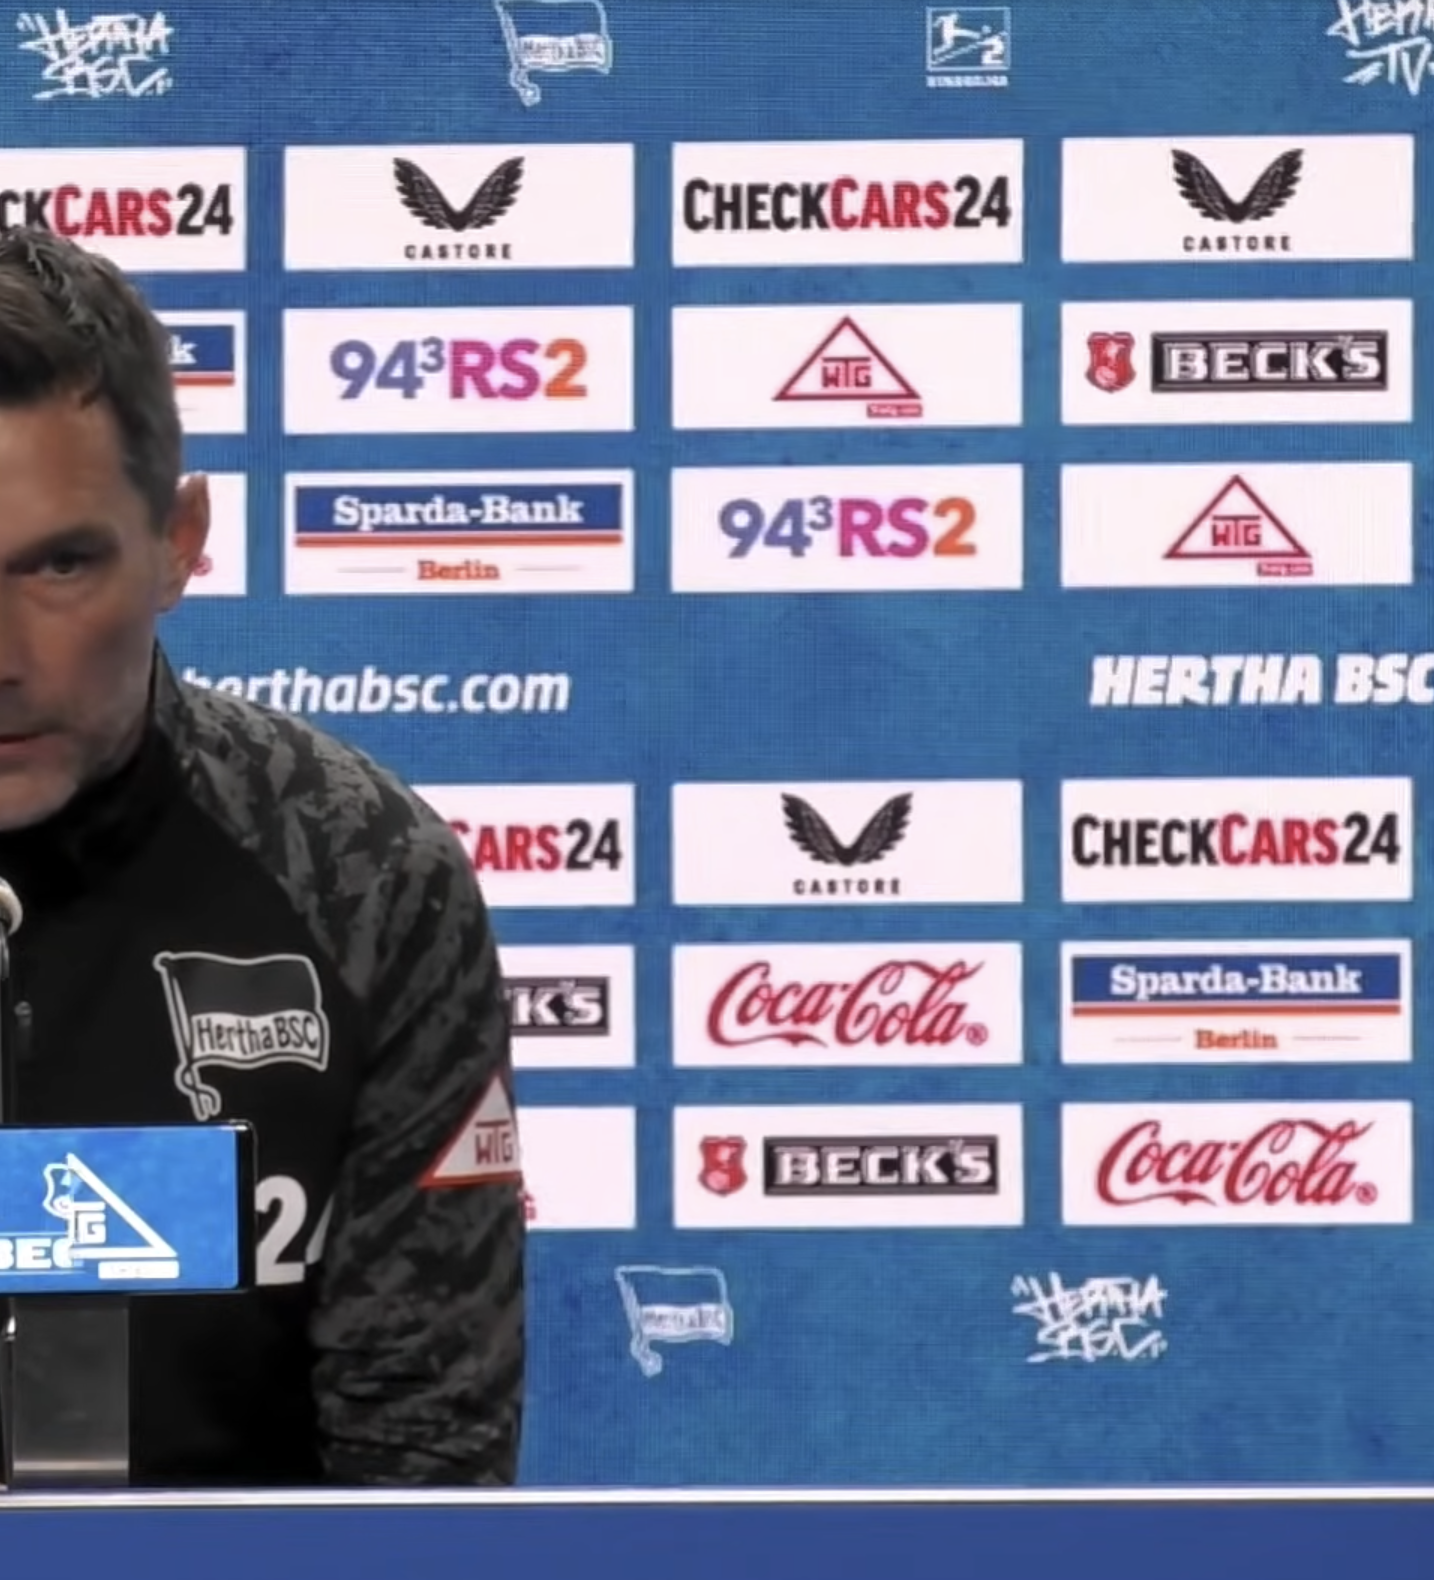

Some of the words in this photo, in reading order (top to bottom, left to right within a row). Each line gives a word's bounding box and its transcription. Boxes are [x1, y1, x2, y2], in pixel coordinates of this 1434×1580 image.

[404, 243, 513, 260] CASTORE
[1183, 235, 1292, 252] CASTORE
[1164, 334, 1381, 382] BECK'S
[332, 492, 583, 531] Sparda-Bank
[417, 558, 501, 581] Berlin
[1090, 654, 1324, 707] HERTHA
[1334, 653, 1434, 705] BSC
[793, 877, 901, 895] CASTORE
[1109, 963, 1363, 1000] Sparda-Bank
[707, 960, 986, 1048] Coca-Cola
[1194, 1028, 1279, 1050] Berlin
[772, 1138, 993, 1186] BECK'S
[1096, 1119, 1378, 1206] Coca-Cola
